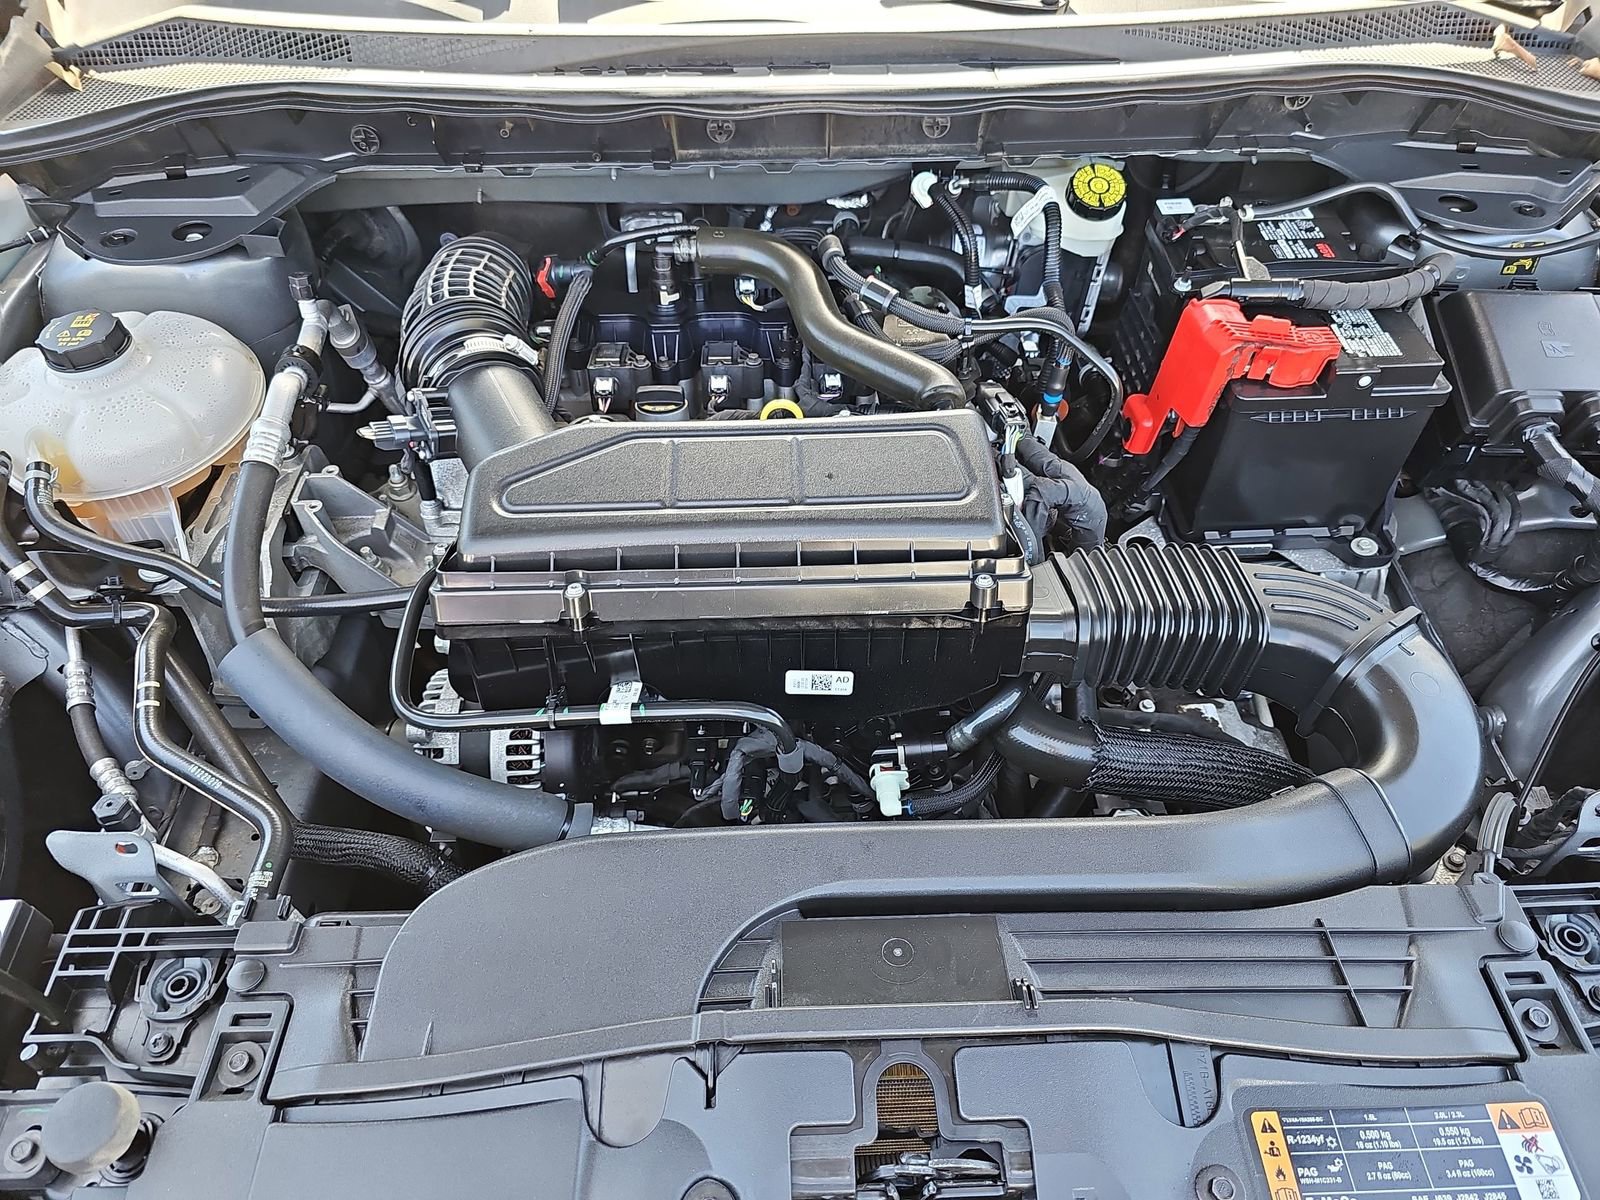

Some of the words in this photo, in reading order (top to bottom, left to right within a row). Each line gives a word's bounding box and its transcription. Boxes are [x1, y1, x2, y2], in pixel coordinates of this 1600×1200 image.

[1359, 1130, 1380, 1140] 0.500
[1380, 1129, 1391, 1140] kg
[1438, 1126, 1459, 1136] 0.550
[1459, 1126, 1471, 1137] kg
[1286, 1134, 1324, 1146] R-1234yf
[1377, 1161, 1393, 1170] PAG
[1458, 1159, 1474, 1168] PAG
[1297, 1167, 1318, 1177] PAG
[1366, 1172, 1376, 1181] 2.7
[1471, 1169, 1495, 1178] (100cc)
